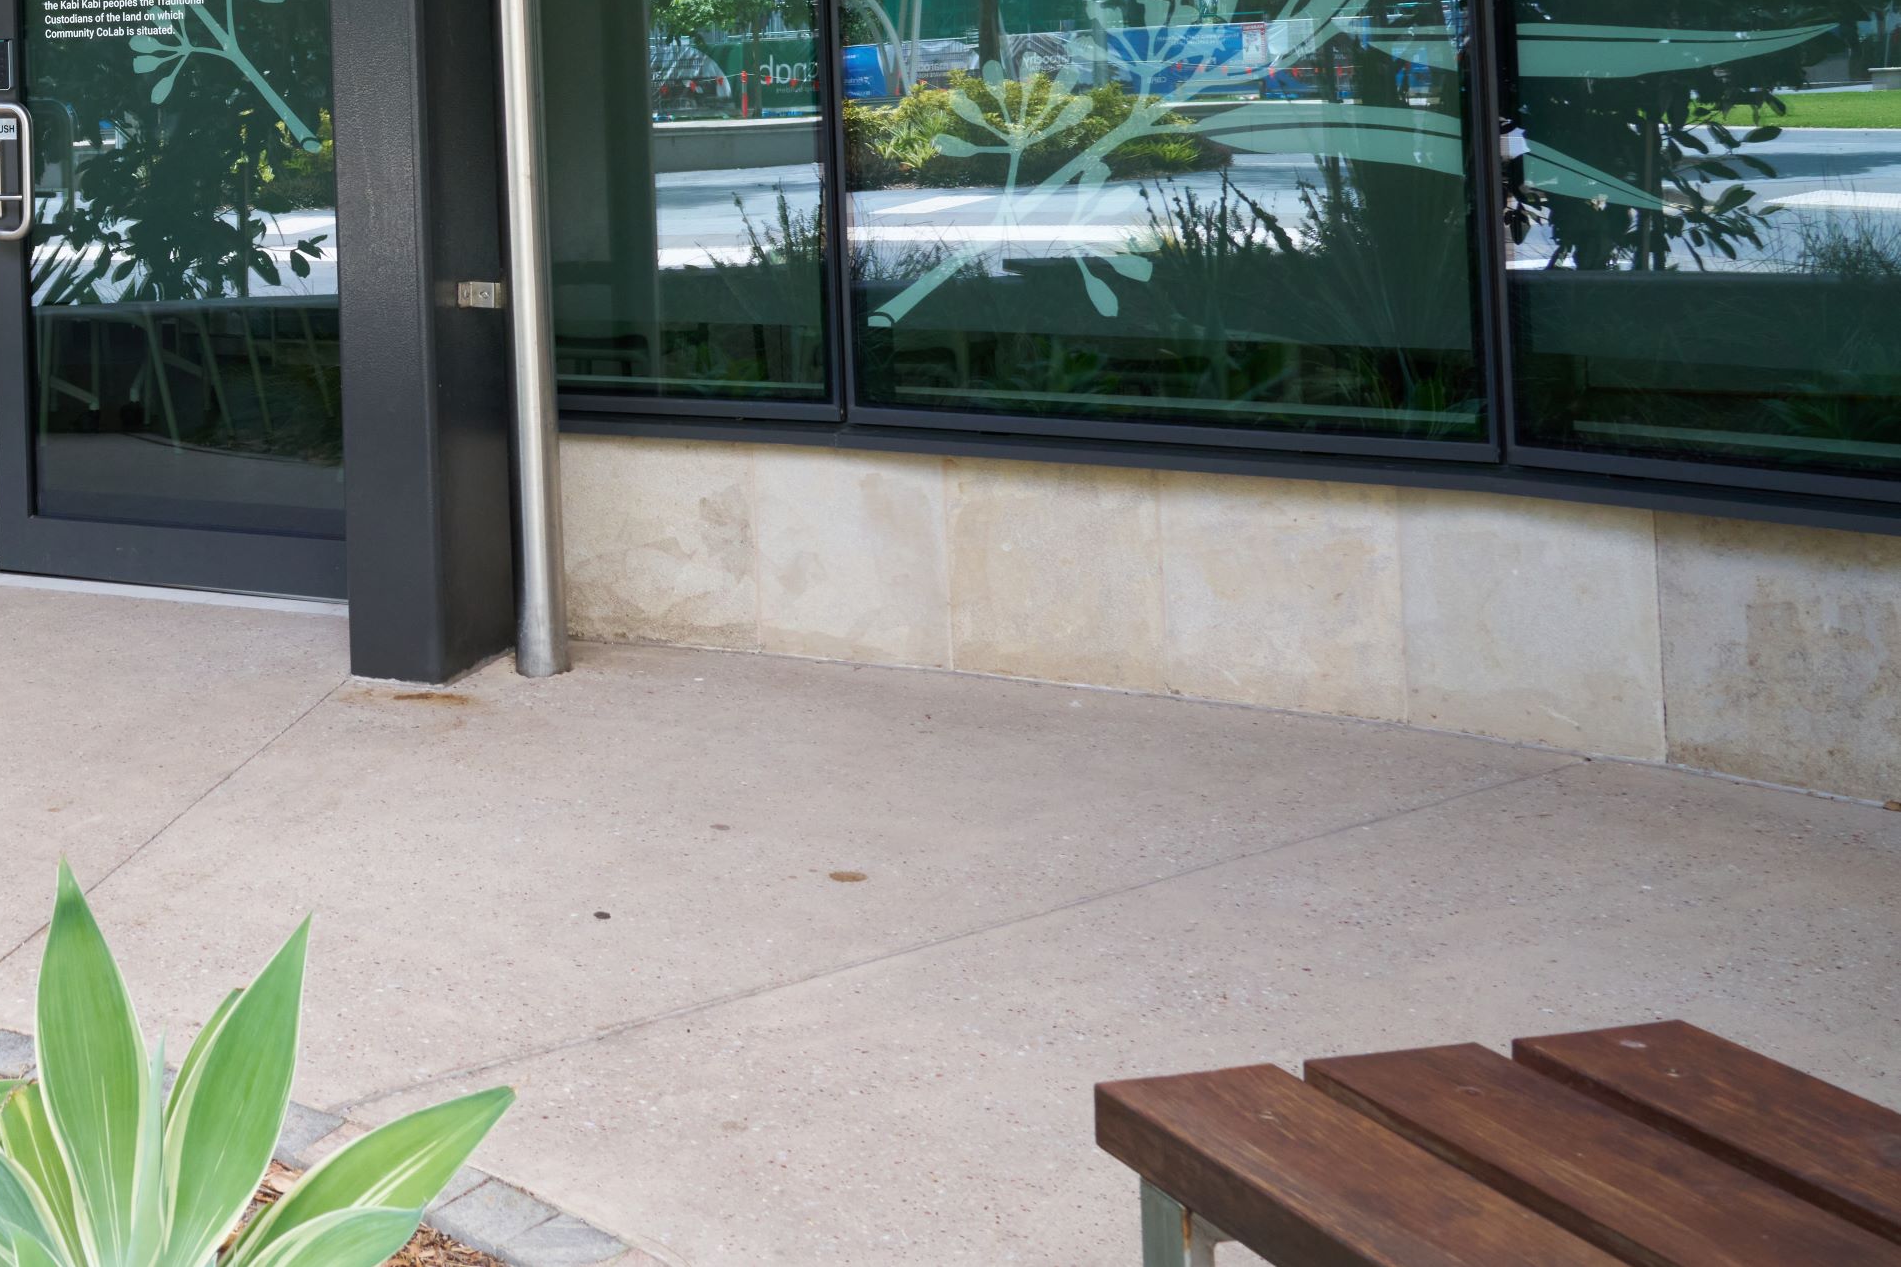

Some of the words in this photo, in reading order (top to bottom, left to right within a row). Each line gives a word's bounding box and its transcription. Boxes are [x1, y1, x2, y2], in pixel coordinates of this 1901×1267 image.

[43, 1, 58, 11] the
[60, 0, 80, 10] Kabi
[81, 0, 101, 9] Kabi
[44, 13, 93, 25] Custodians
[94, 12, 105, 23] of
[106, 12, 121, 22] the
[122, 11, 142, 22] land
[143, 13, 156, 21] on
[156, 10, 184, 20] which
[45, 27, 94, 39] Community
[96, 27, 125, 37] CoLab
[126, 26, 135, 36] is
[136, 25, 175, 36] situated.
